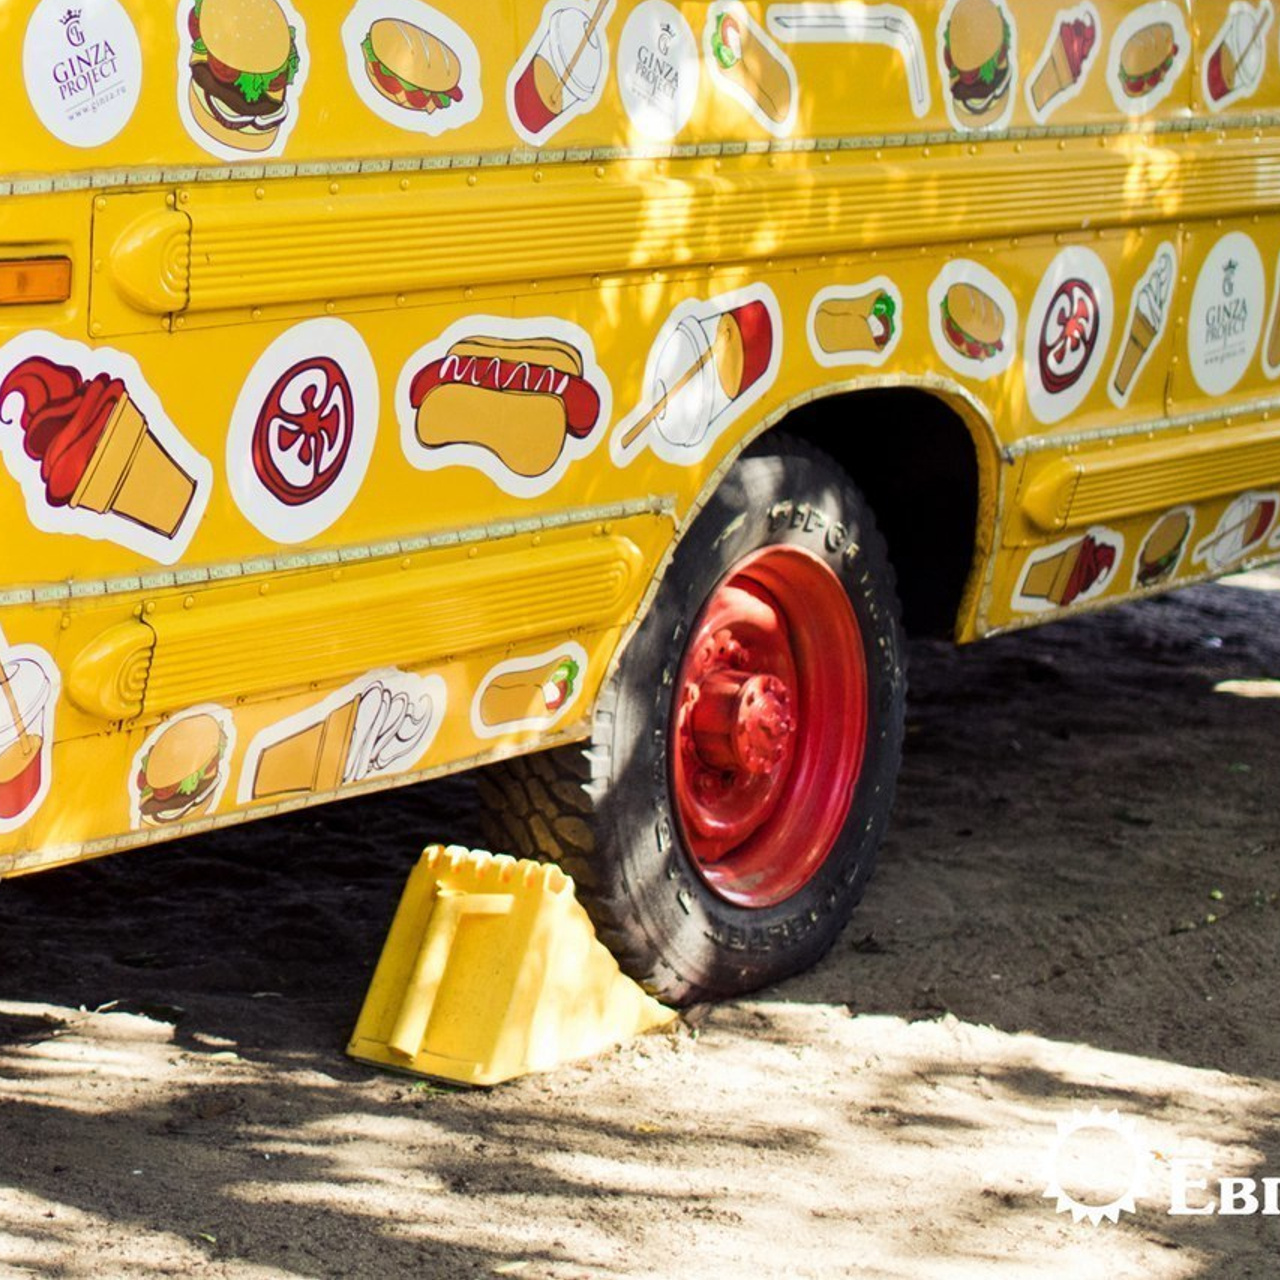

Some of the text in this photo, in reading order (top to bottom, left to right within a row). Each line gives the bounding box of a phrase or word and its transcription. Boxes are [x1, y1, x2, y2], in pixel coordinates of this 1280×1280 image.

[52, 40, 116, 85] GINZA
[58, 57, 118, 101] PROJECT
[637, 45, 680, 89] GINZA
[68, 85, 127, 121] www.ginza.ru
[1205, 298, 1248, 328] GINZA
[1205, 316, 1247, 351] PROJECT
